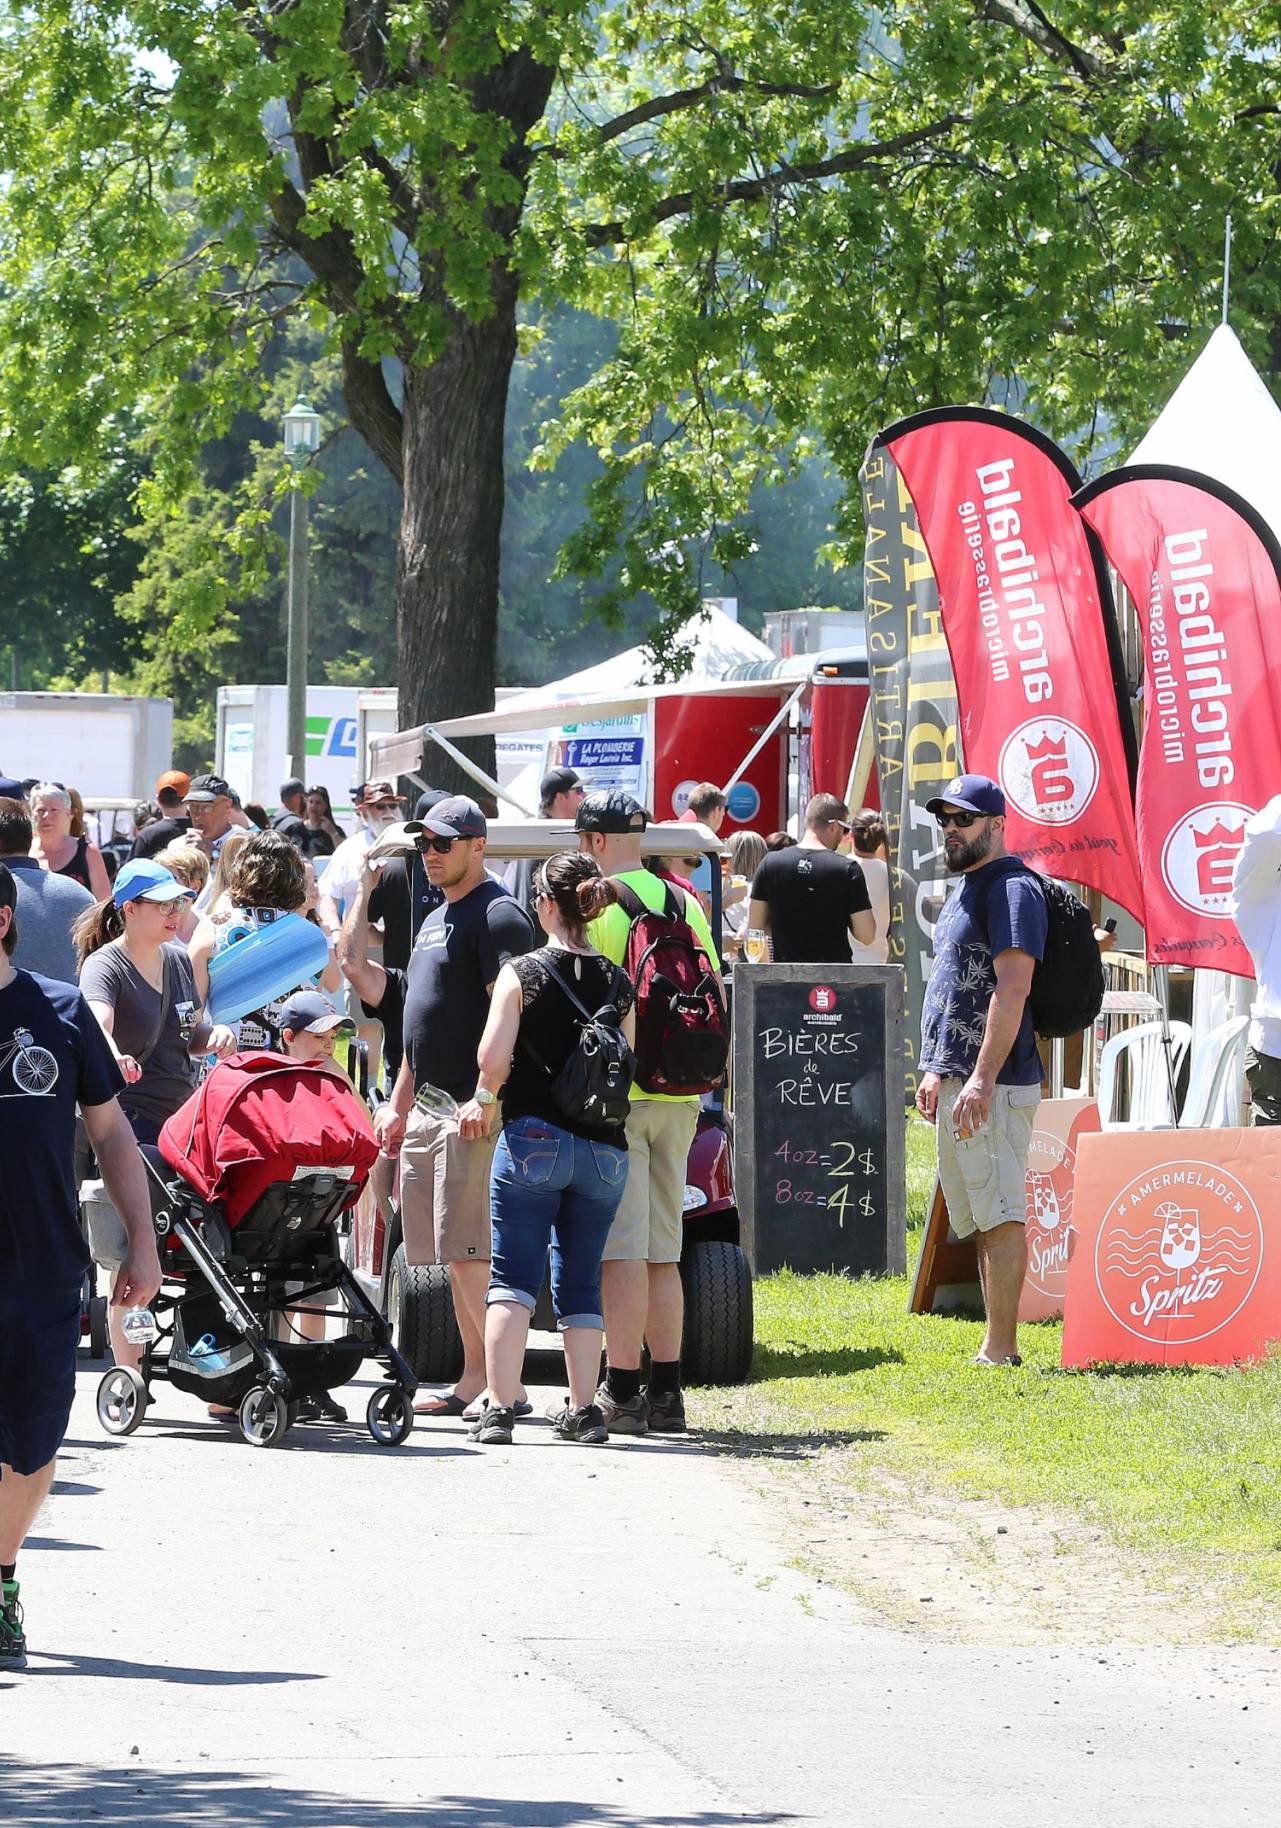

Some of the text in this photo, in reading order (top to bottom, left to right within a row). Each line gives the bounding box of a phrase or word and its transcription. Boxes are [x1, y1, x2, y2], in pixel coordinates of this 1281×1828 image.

[581, 743, 591, 754] LA
[803, 1013, 843, 1022] archibald
[803, 1058, 820, 1075] de
[775, 1076, 852, 1106] RÊVE
[1029, 1142, 1072, 1169] MELADE
[1131, 1171, 1236, 1206] AMERMELADE
[1029, 1228, 1072, 1283] Sprit
[1130, 1266, 1228, 1326] Spritz
